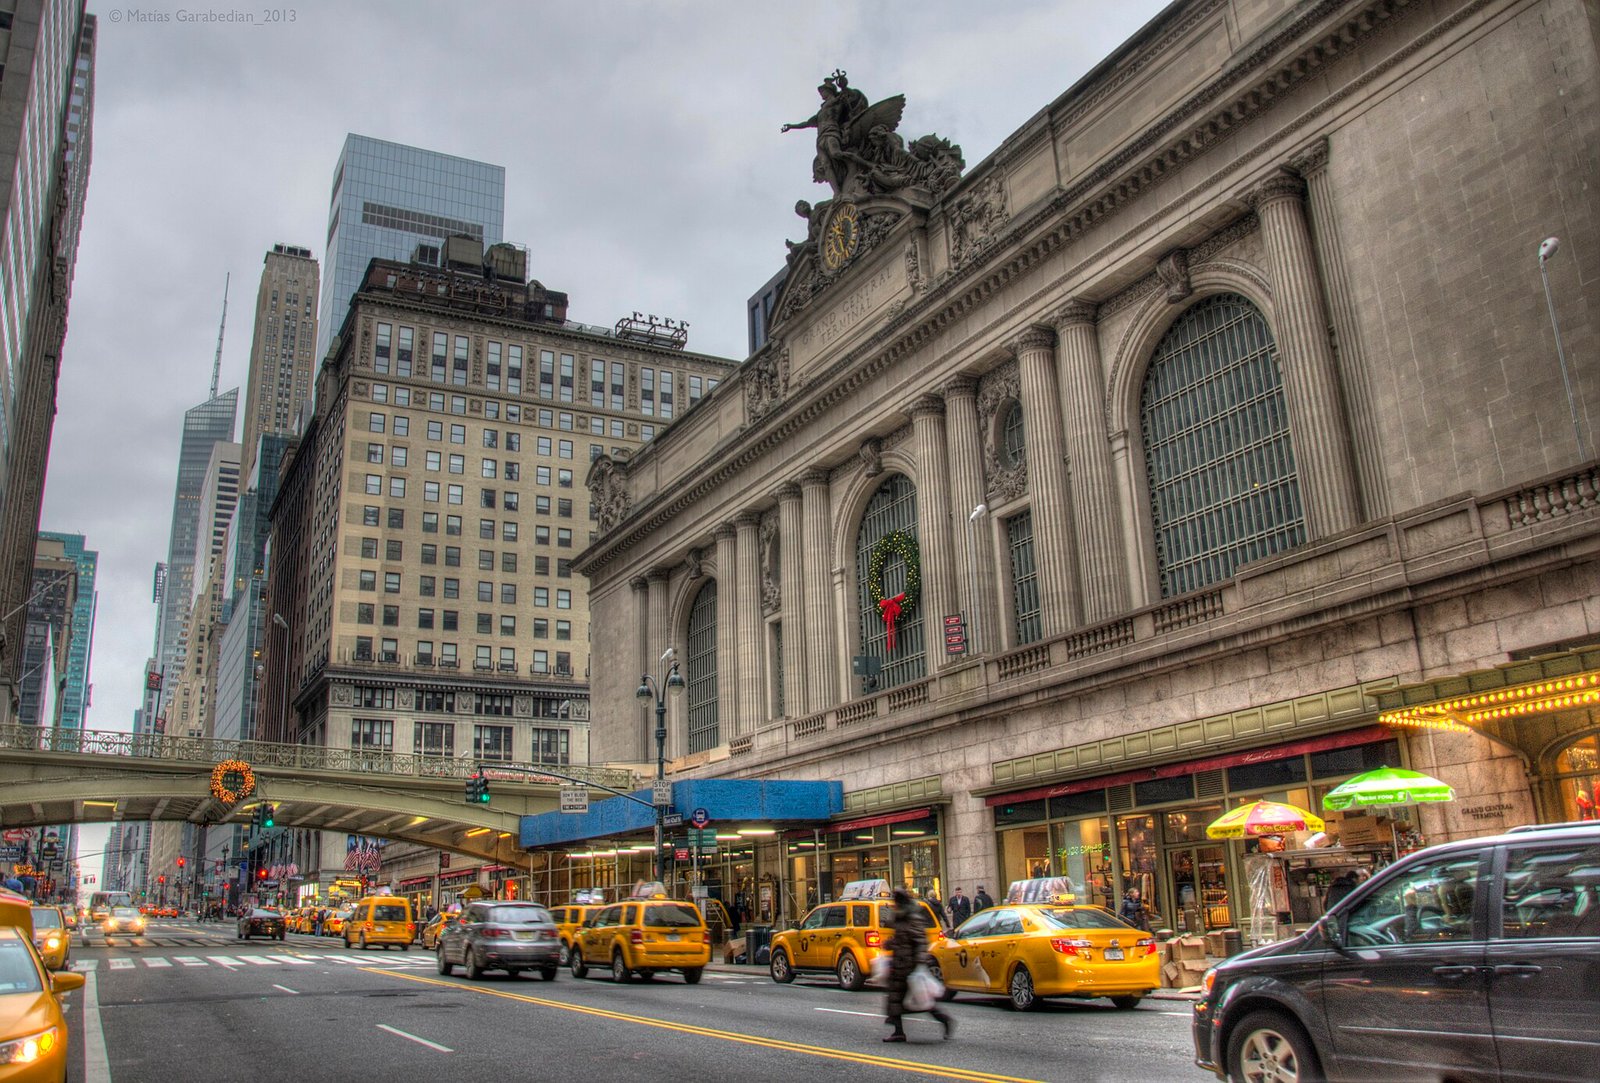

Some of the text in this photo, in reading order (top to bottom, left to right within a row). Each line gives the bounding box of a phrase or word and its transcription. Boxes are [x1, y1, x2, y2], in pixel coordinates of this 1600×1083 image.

[802, 266, 893, 345] GRAND CENTRAL
[821, 298, 872, 344] TERMINAL
[1461, 803, 1514, 815] GRAND CENTRAL
[1472, 811, 1504, 820] TERMINAL
